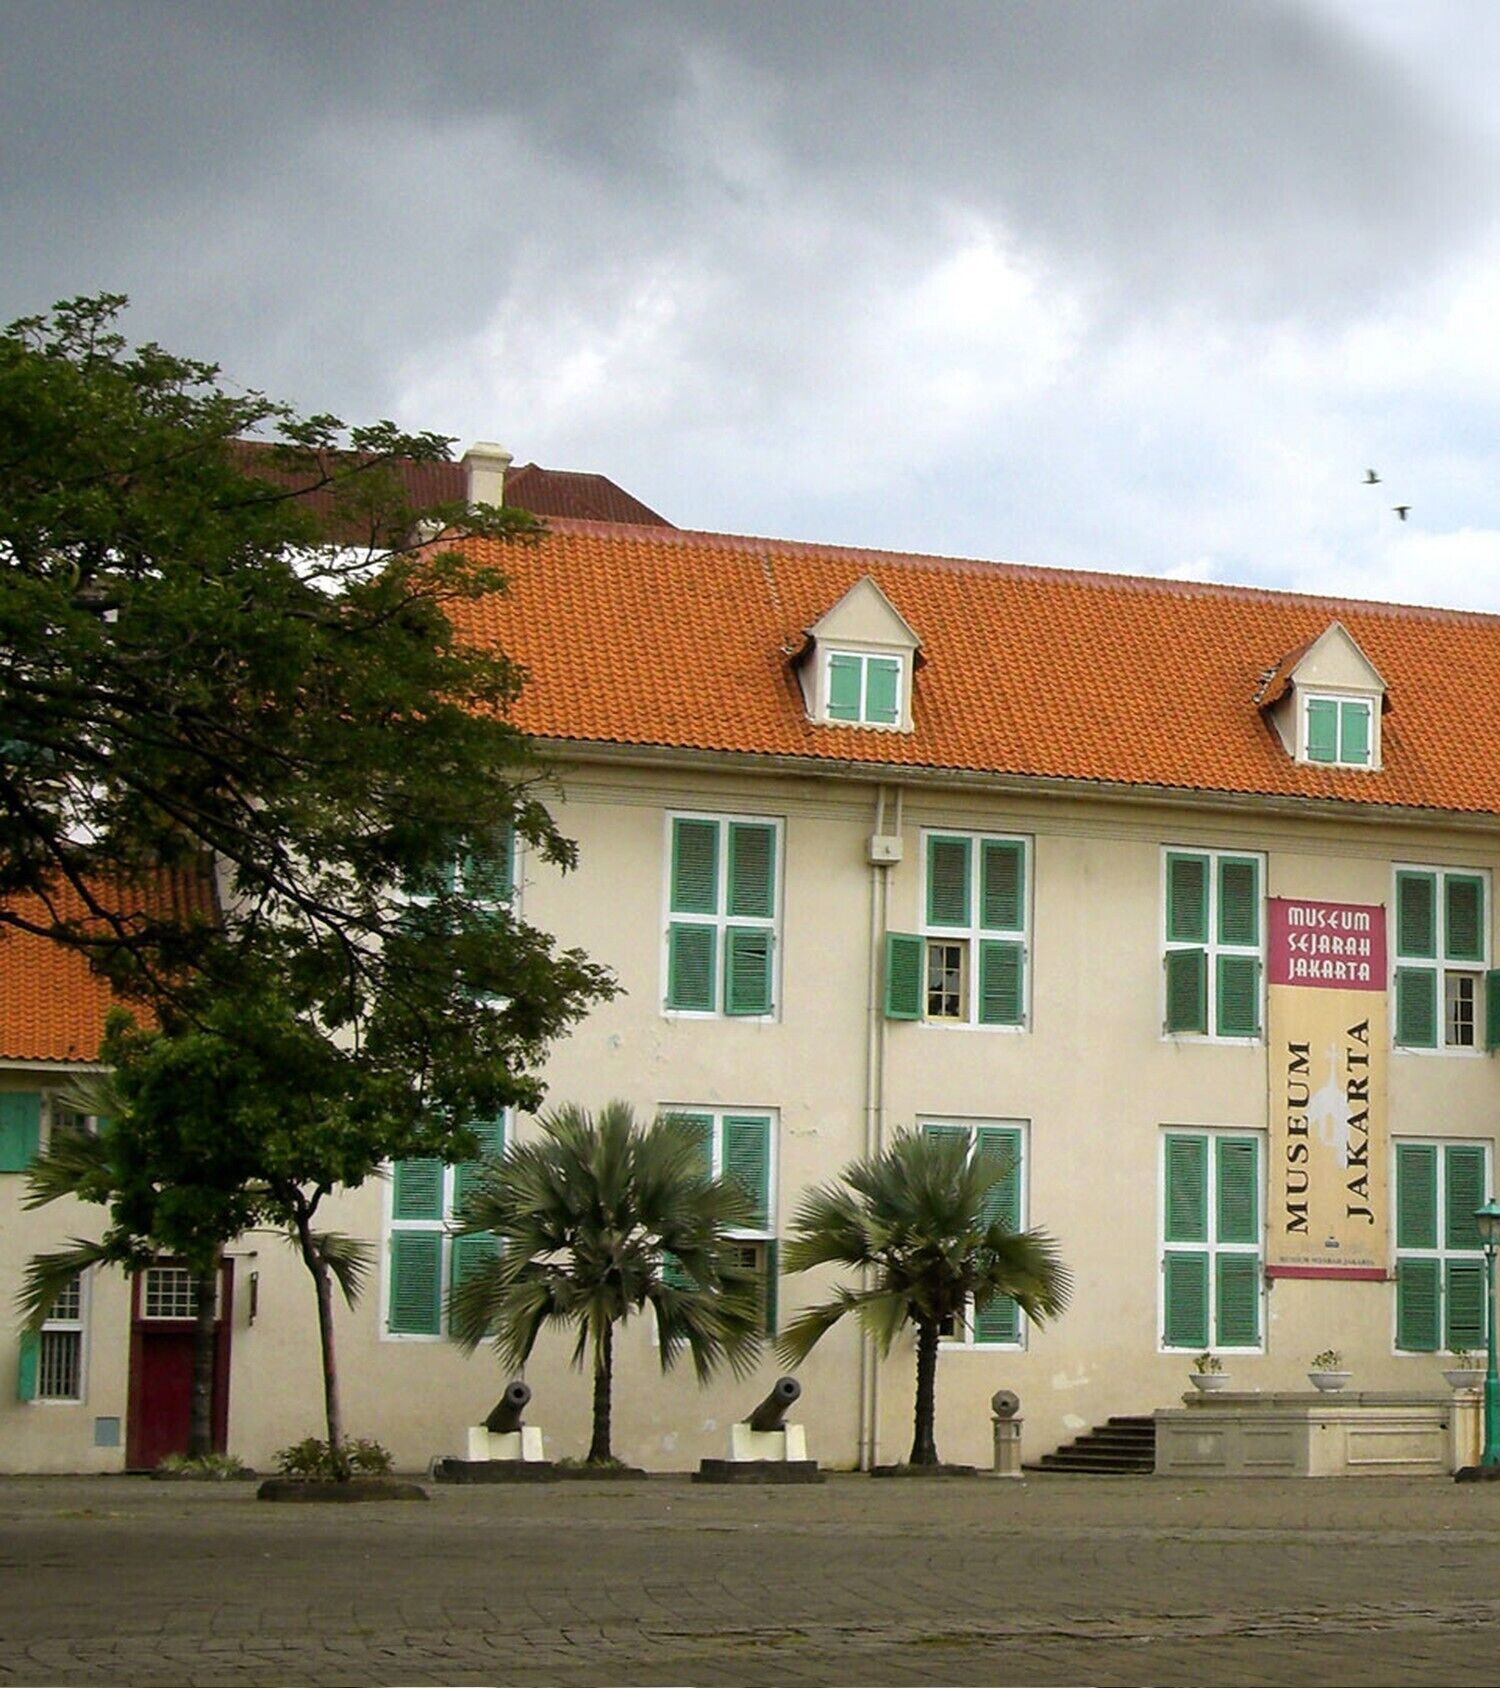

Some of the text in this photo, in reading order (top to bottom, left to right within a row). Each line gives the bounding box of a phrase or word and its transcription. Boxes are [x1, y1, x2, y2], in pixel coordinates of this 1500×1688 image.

[1288, 906, 1370, 931] MUSEUM
[1287, 932, 1371, 957] SEJARAH
[1287, 957, 1371, 982] JAKARTA
[1346, 1018, 1375, 1225] JAKARTA
[1285, 1041, 1311, 1236] MUSEUM
